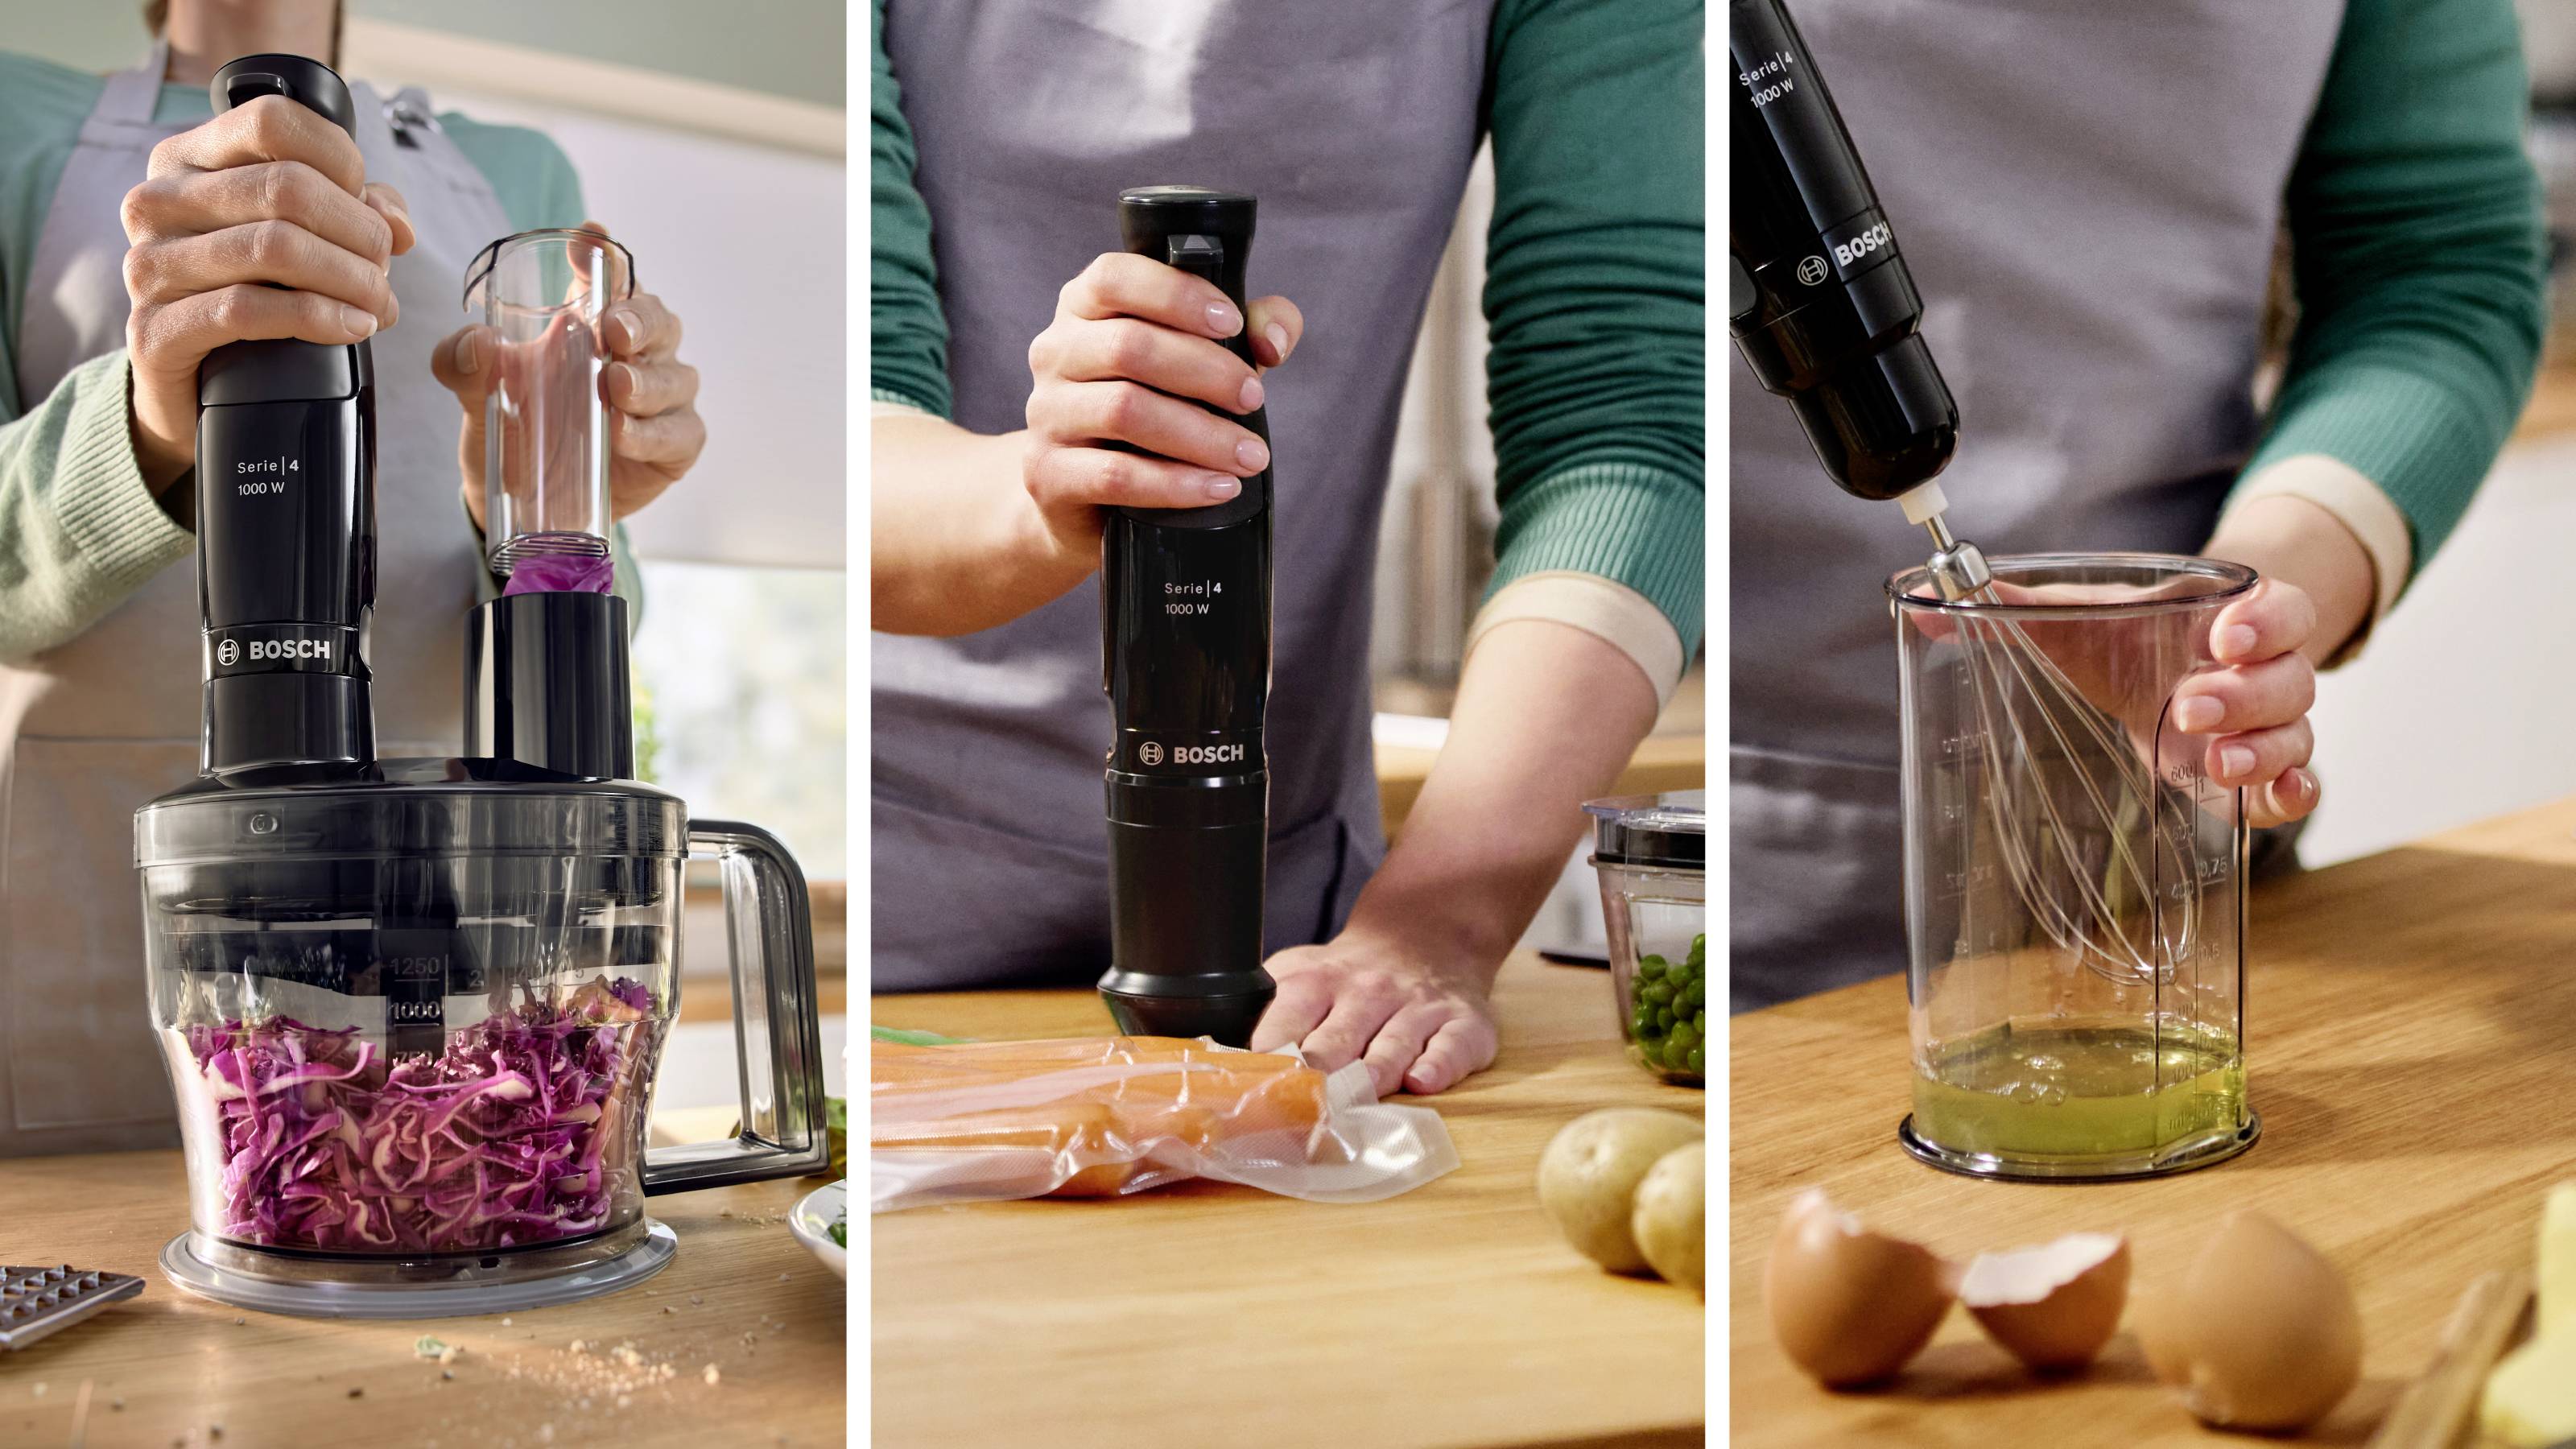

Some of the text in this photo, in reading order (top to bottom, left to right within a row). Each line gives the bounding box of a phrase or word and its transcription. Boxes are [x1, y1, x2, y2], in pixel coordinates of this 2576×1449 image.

[1750, 78, 1794, 108] 1000 W
[1834, 221, 1893, 267] BOSCH
[237, 481, 285, 496] 1000 W
[1165, 604, 1210, 615] 1000 W
[250, 639, 331, 660] BOSCH
[1174, 744, 1245, 764] BOSCH
[390, 956, 441, 976] 1250
[390, 1000, 441, 1020] 1000
